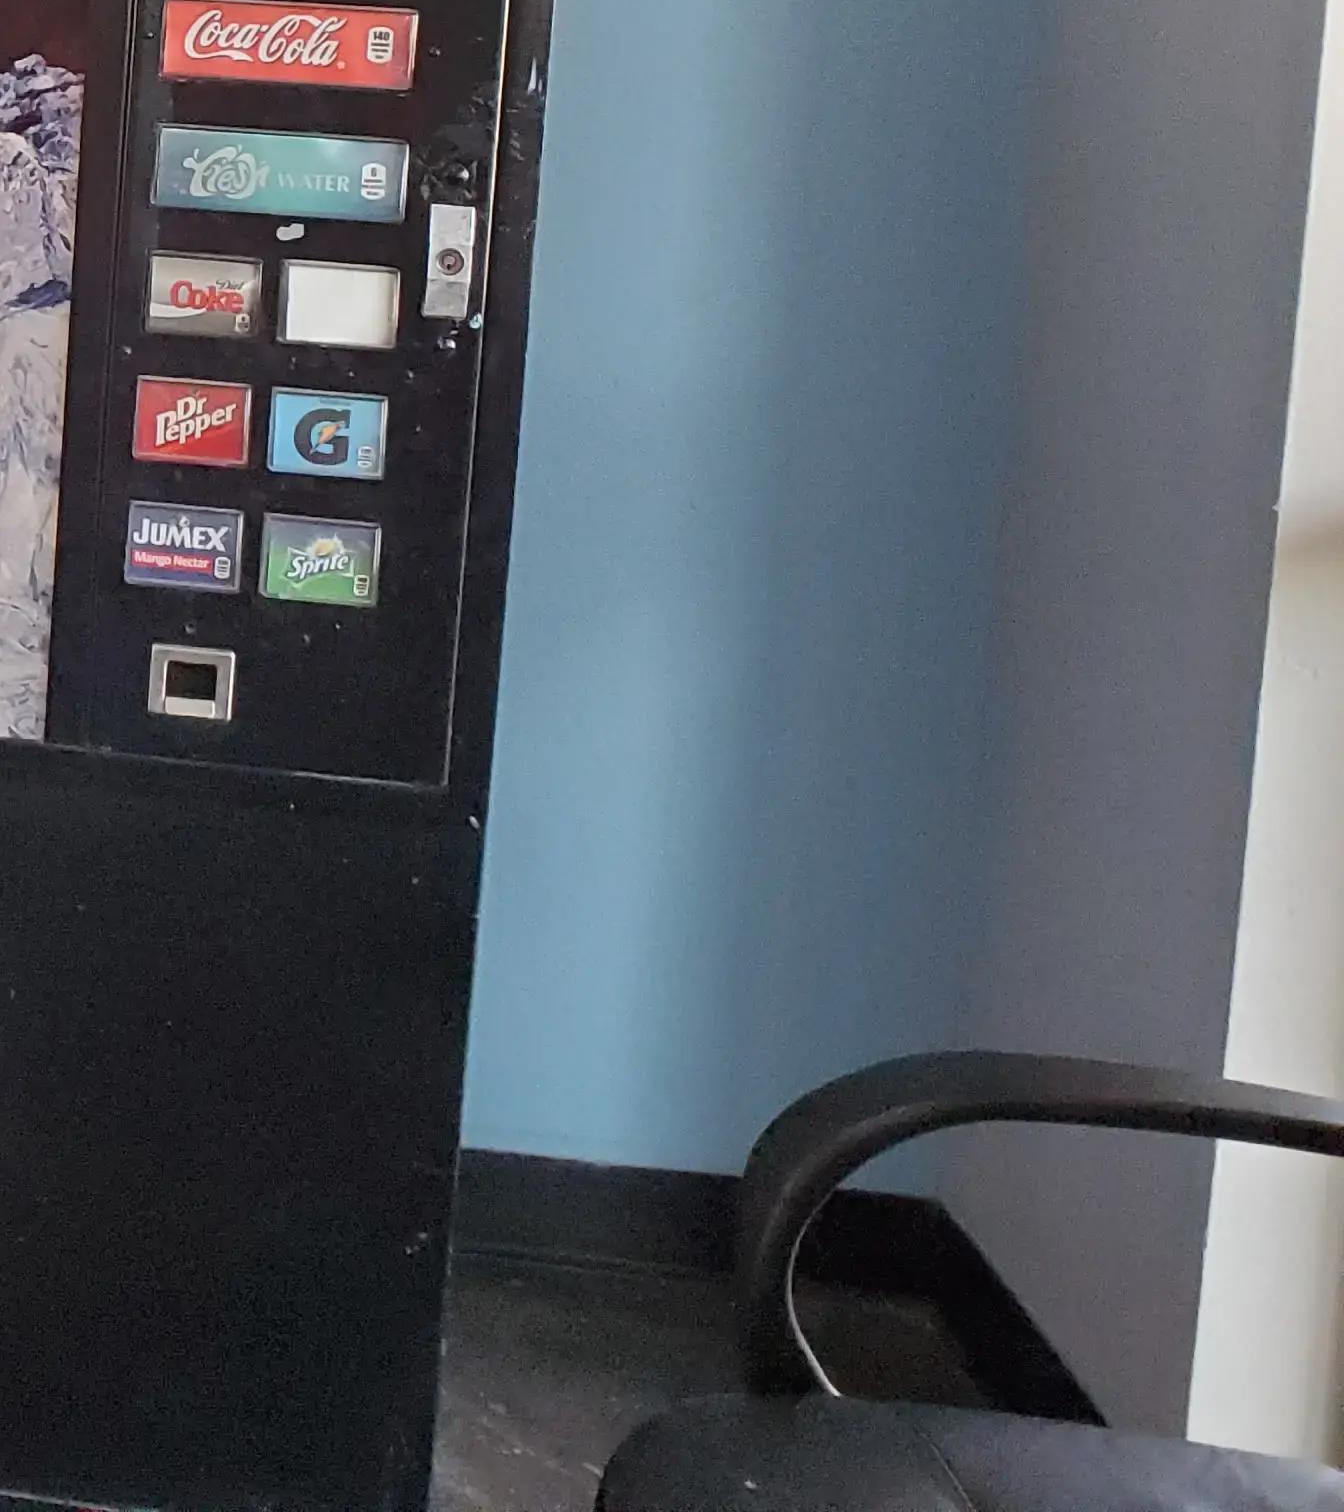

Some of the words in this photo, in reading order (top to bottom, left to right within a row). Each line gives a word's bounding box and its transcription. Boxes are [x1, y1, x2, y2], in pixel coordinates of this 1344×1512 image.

[184, 9, 348, 67] Coca-Cola
[278, 172, 350, 194] WATER
[169, 279, 245, 314] Coke
[176, 395, 207, 416] Dr
[155, 402, 237, 447] Pepper
[293, 407, 352, 466] G
[133, 517, 230, 552] JUMEX
[135, 549, 171, 568] Mango
[173, 553, 209, 569] Nectar
[287, 552, 350, 580] Sprite
